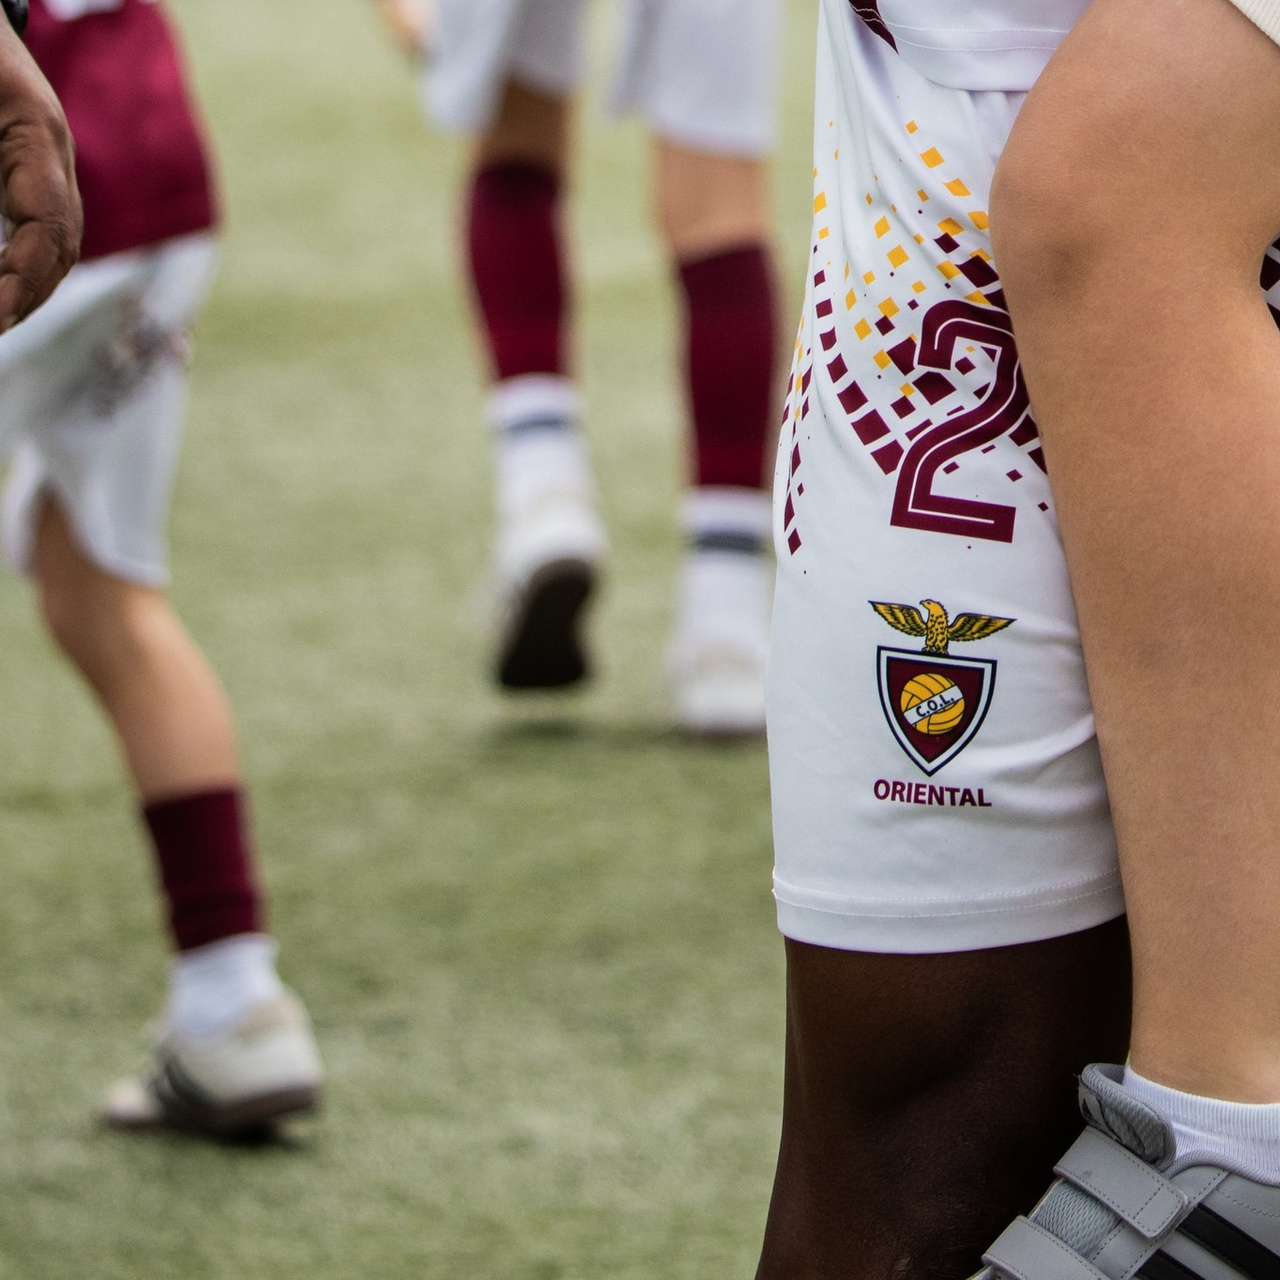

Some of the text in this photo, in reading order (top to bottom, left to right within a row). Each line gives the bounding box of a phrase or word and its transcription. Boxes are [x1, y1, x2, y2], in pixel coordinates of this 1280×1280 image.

[889, 298, 1033, 545] 2
[915, 693, 956, 718] C.O.L.
[872, 778, 993, 808] ORIENTAL
